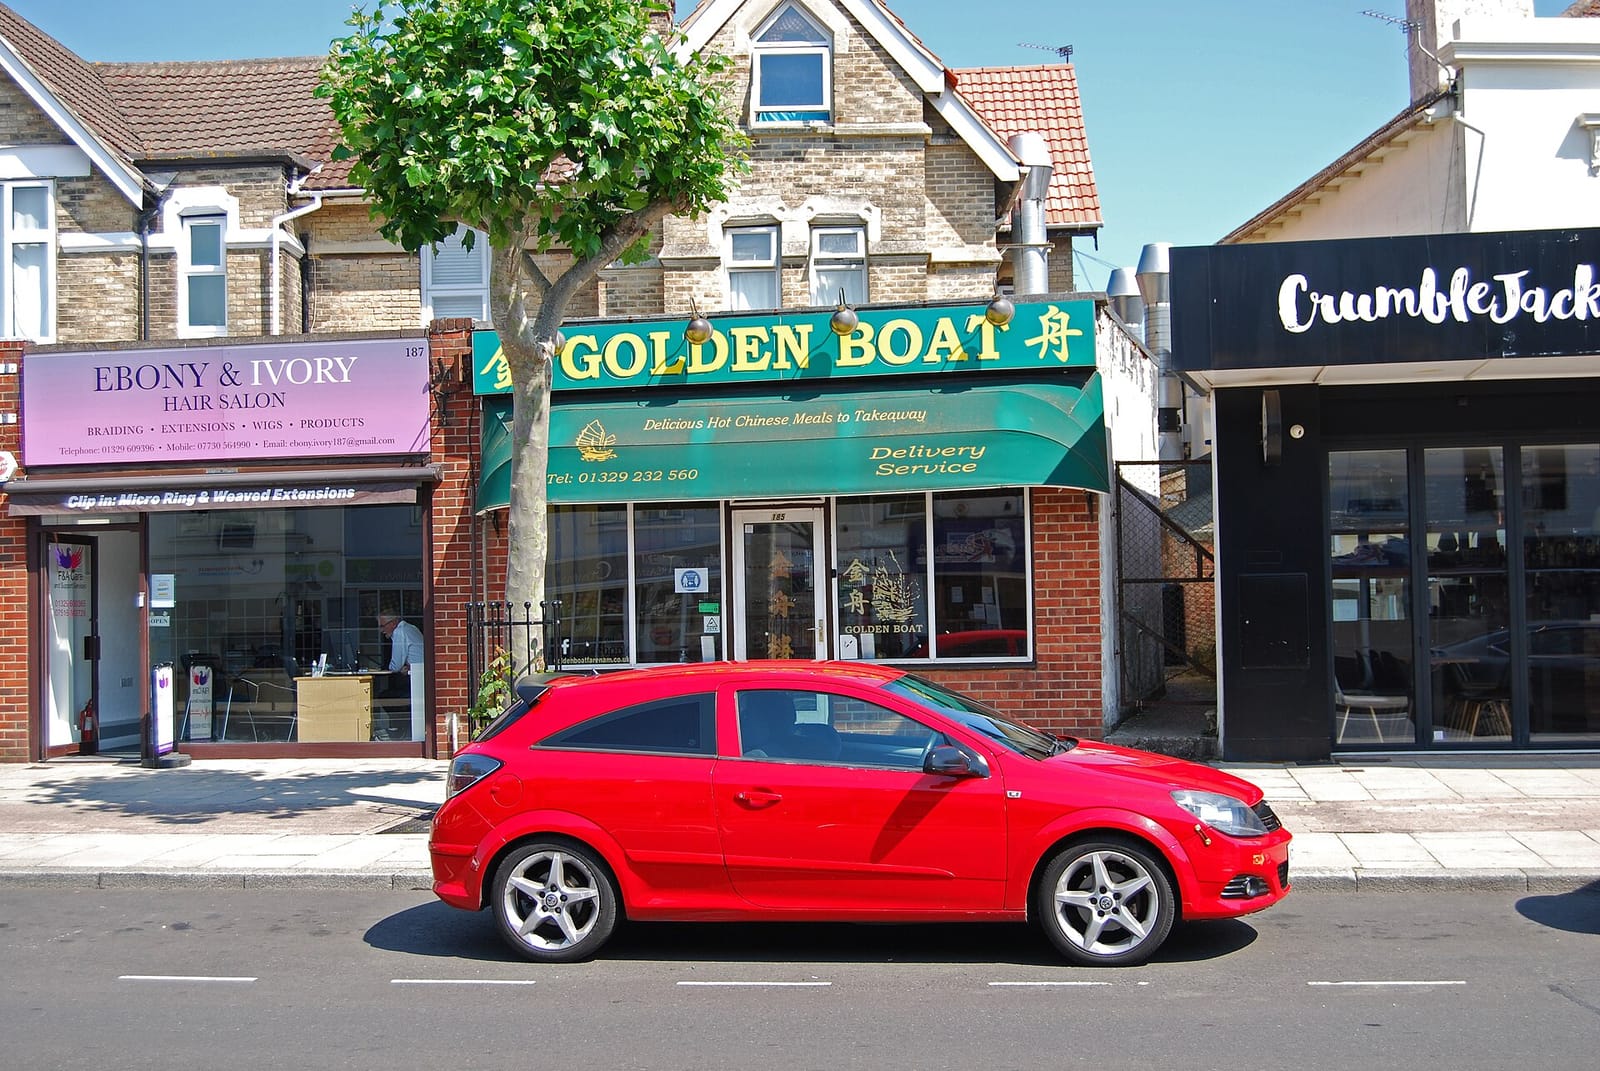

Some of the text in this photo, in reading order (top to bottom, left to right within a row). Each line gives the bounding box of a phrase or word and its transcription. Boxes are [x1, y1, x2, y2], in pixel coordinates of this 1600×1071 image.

[1024, 304, 1084, 363] 舟
[405, 347, 425, 358] 187
[558, 324, 814, 381] GOLDEN
[835, 313, 1010, 368] BOAT
[93, 356, 358, 392] EBONY & IVORY
[163, 391, 286, 412] HAIR SALON
[87, 417, 365, 436] BRAIDING EXTENSIONS WIGS PRODUCTS
[643, 409, 927, 431] Delicious Hot Chinese Meals to Takeaway
[59, 446, 100, 457] Telephone:
[101, 445, 125, 454] 01329
[126, 443, 155, 453] 609396
[166, 442, 196, 451] Mobile:
[197, 441, 221, 450] 07730
[263, 439, 288, 448] Email:
[289, 436, 395, 448] ebony.ivory187@gmail.com
[868, 444, 986, 460] Delivery
[547, 469, 699, 484] Tel: 01329 232 560
[875, 460, 978, 476] Service
[67, 486, 356, 510] Clip in: Micro Ring & Weaved Extensions
[772, 512, 786, 521] 185
[844, 624, 924, 634] GOLDEN BOAT
